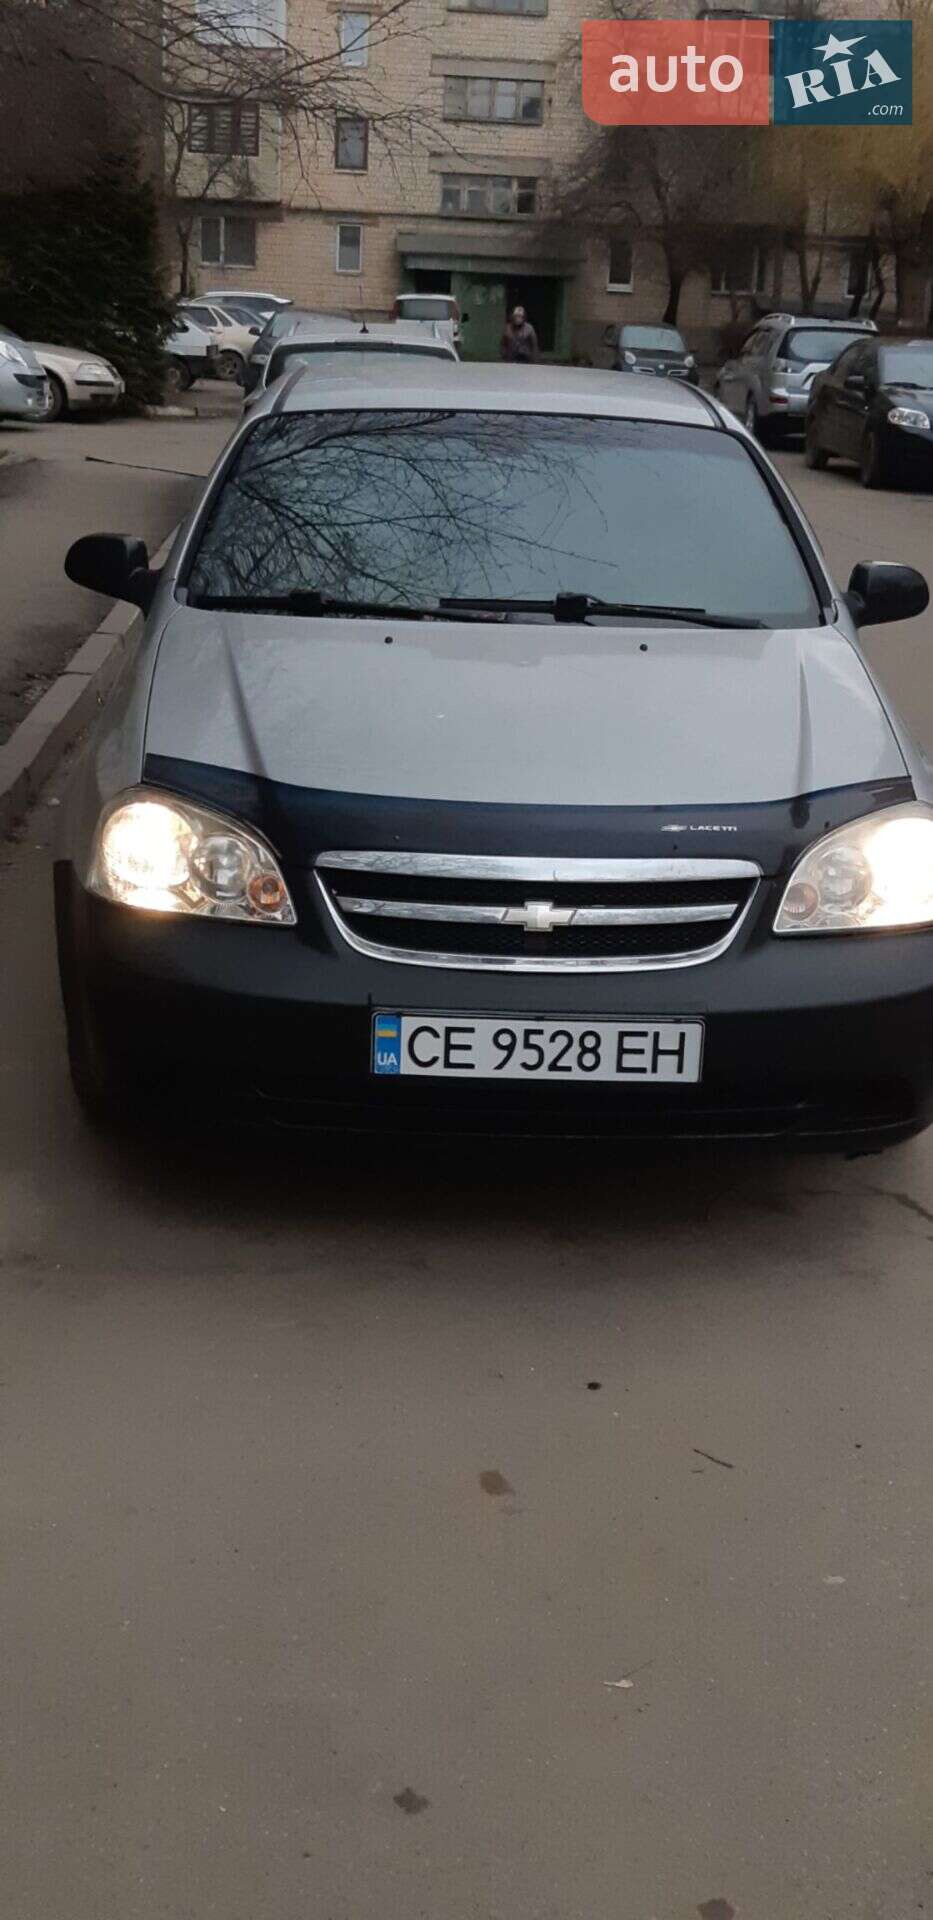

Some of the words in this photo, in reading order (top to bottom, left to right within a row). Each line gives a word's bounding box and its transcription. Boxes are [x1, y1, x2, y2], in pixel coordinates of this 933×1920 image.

[377, 1052, 398, 1066] UA
[407, 1025, 476, 1070] CE
[492, 1028, 602, 1073] 9528
[615, 1030, 686, 1074] EH
